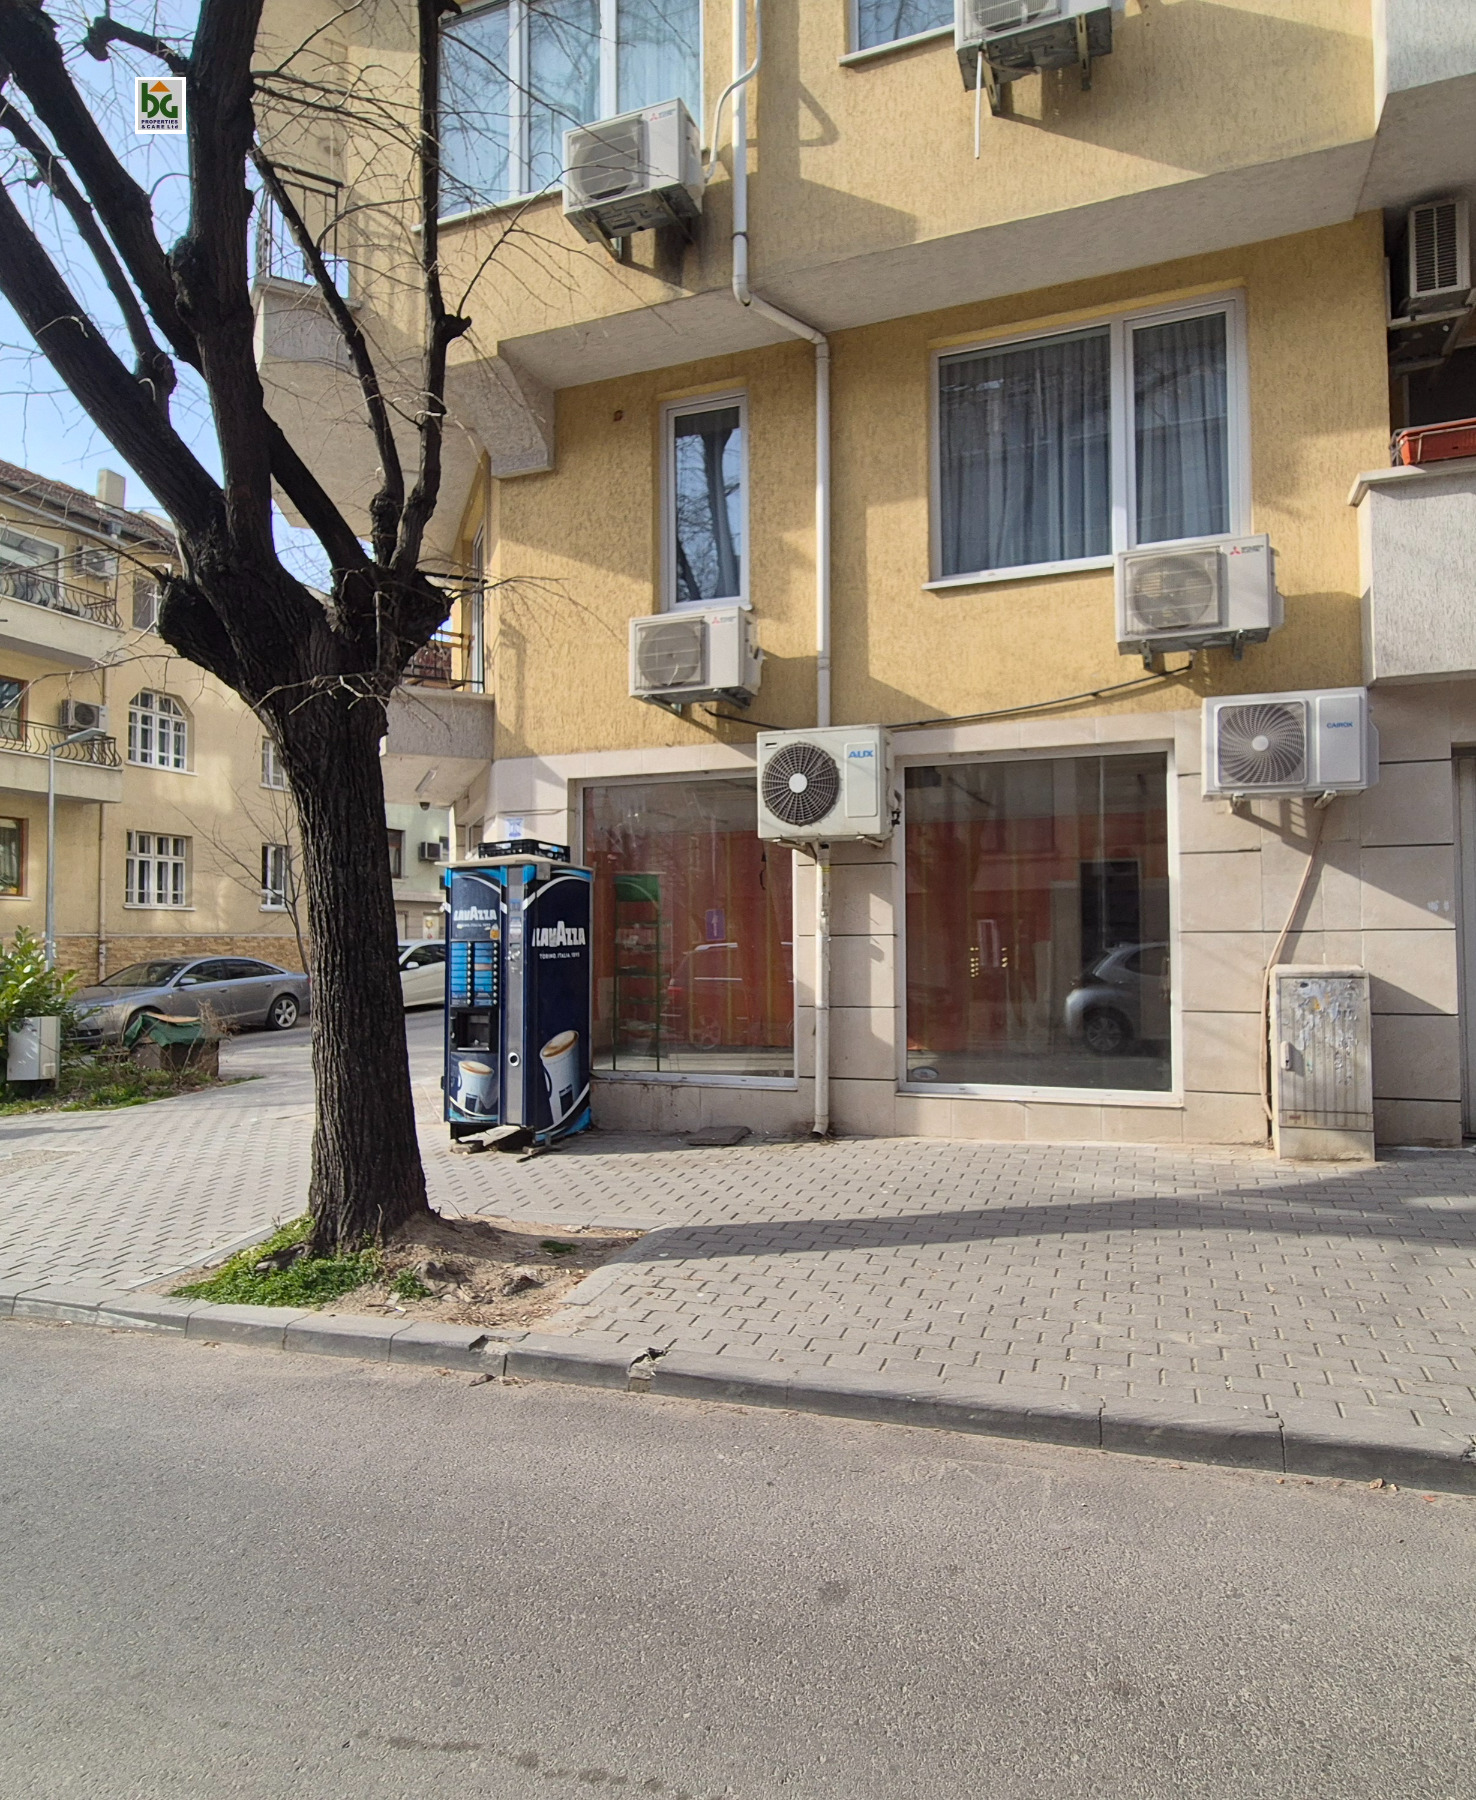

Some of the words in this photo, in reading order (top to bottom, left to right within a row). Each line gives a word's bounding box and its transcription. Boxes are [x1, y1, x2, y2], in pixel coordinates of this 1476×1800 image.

[848, 750, 873, 758] AUX
[454, 906, 497, 921] LAVAZZA
[532, 921, 586, 947] LAVAZZA
